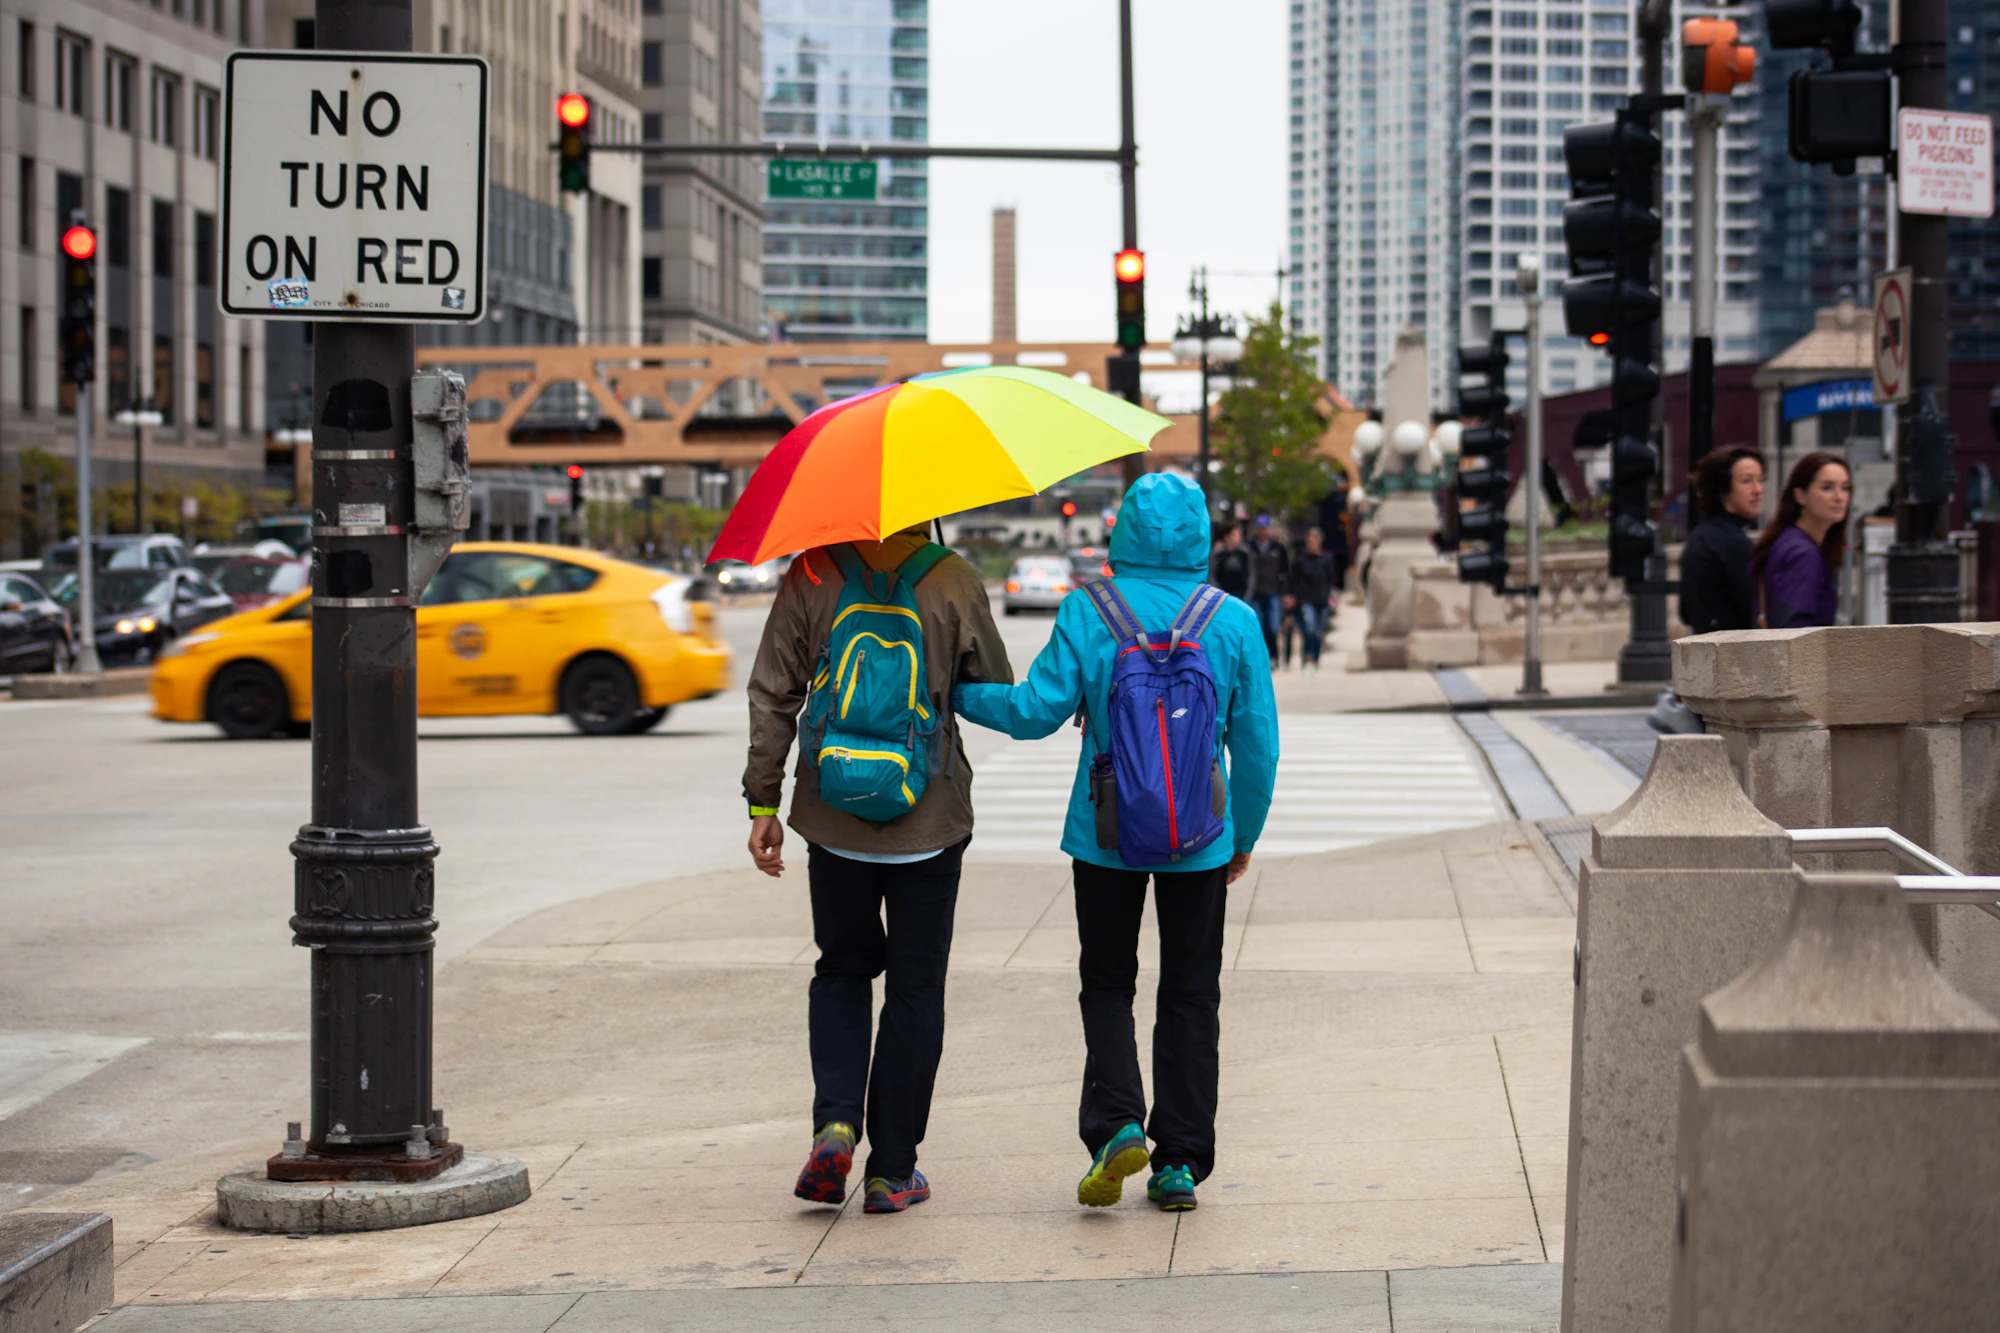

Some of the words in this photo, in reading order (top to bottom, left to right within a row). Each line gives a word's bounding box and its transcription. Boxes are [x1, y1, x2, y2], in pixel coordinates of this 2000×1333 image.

[310, 89, 401, 138] NO
[1906, 121, 1923, 140] DO
[1927, 124, 1951, 142] NOT
[1955, 126, 1987, 146] FEED
[1918, 143, 1975, 165] PIGEONS
[280, 161, 429, 212] TURN
[245, 234, 317, 283] ON
[357, 237, 460, 286] RED
[313, 300, 332, 308] CITY
